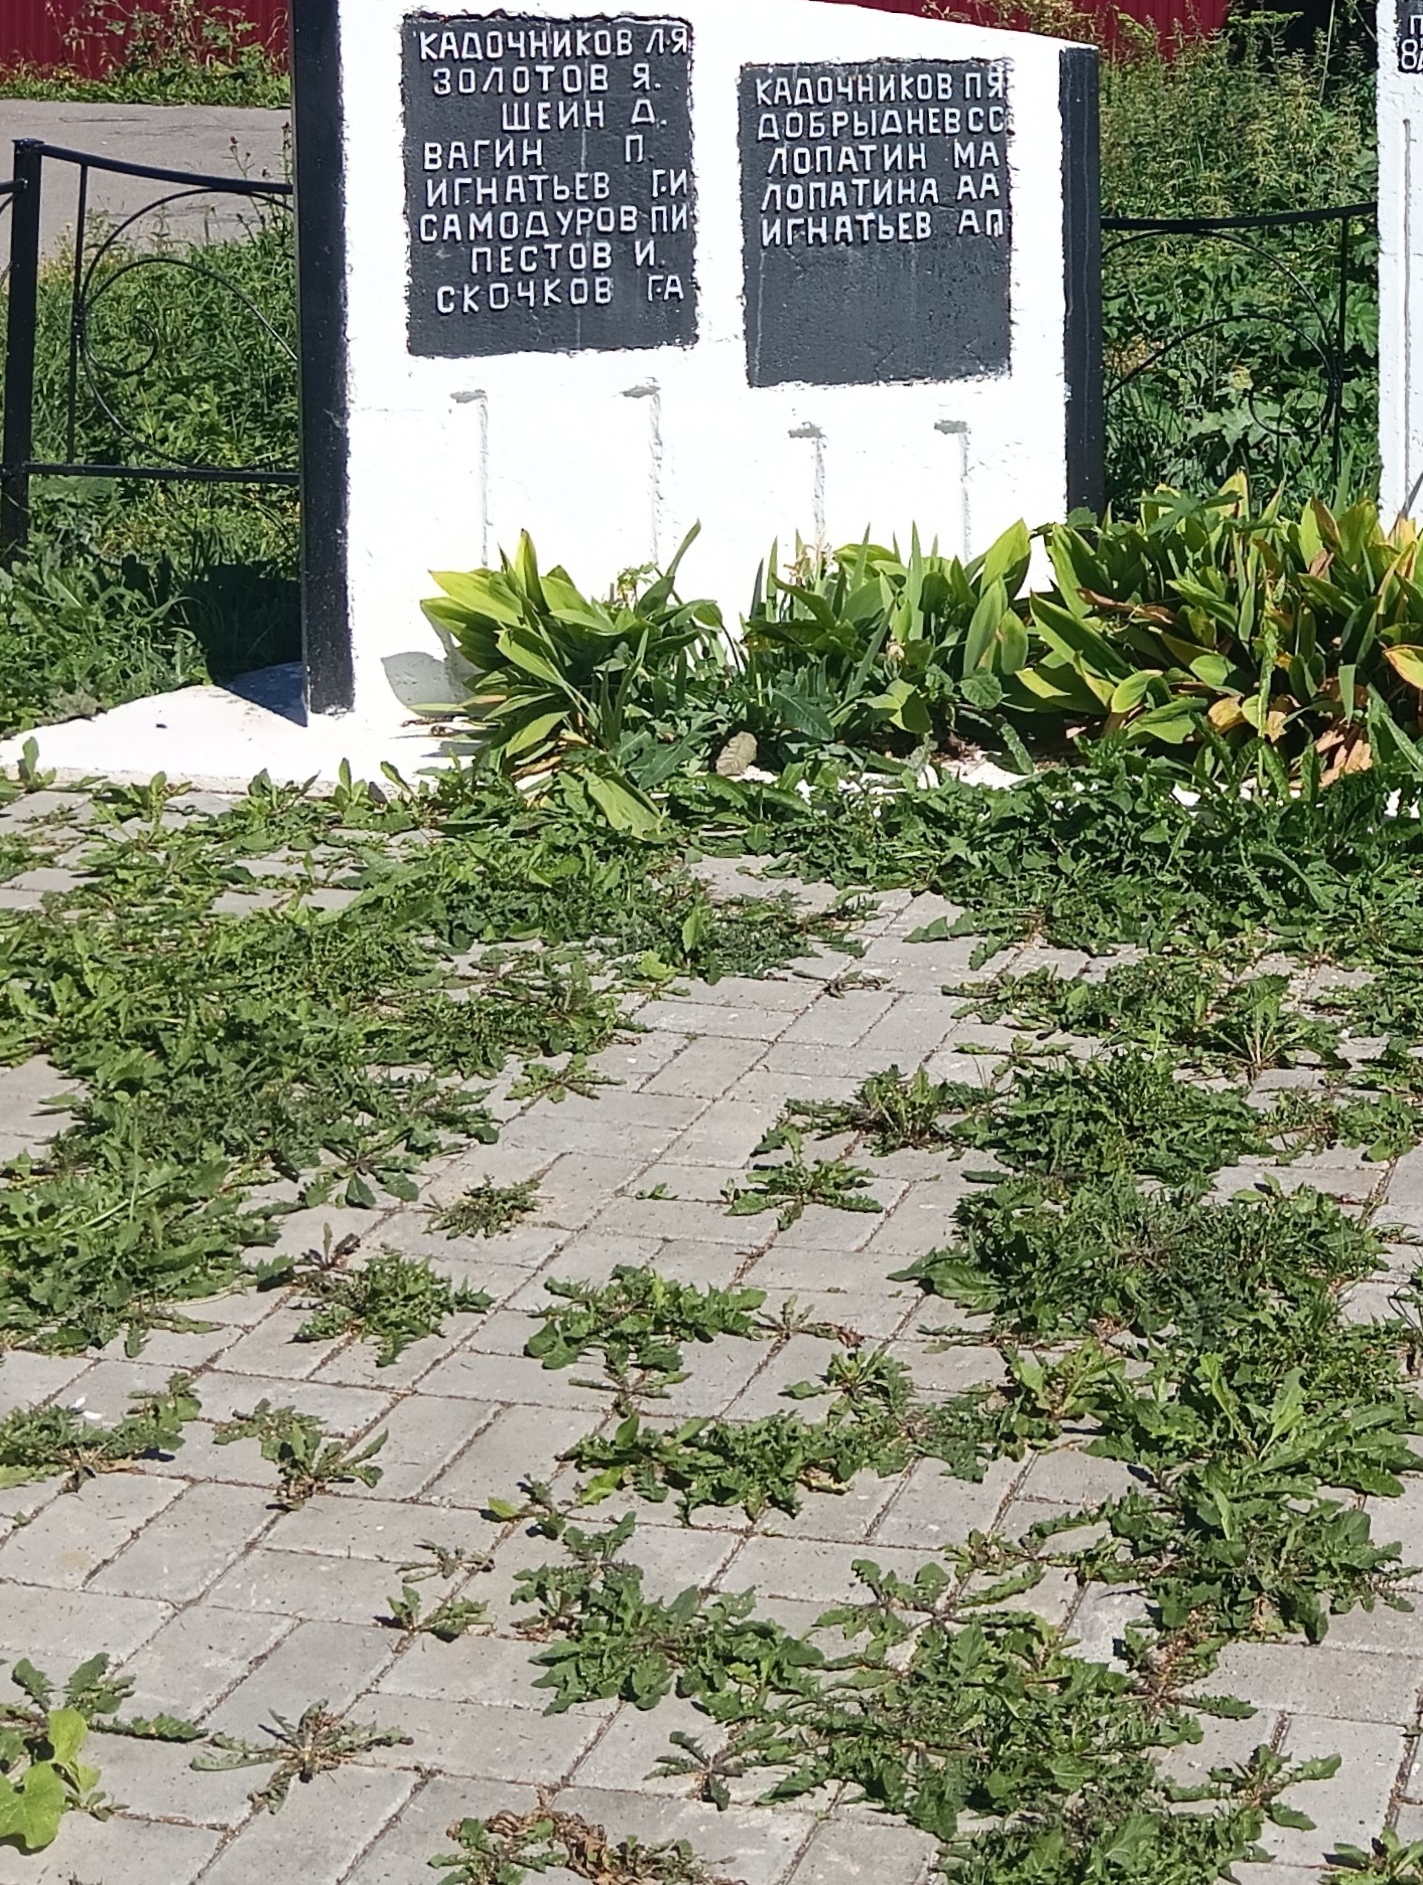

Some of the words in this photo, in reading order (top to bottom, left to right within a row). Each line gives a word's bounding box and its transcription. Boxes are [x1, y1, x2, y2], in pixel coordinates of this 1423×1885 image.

[418, 29, 633, 61] КАДОЧНИКОВ
[432, 64, 609, 96] ЗОЛОТОВ
[755, 73, 953, 106] КАДОЧНИКОВ
[964, 72, 1004, 100] ПЯ
[502, 99, 605, 131] ШЕИН
[756, 107, 961, 142] ДОБРЫДНЕВ
[967, 106, 1005, 133] СС
[423, 139, 543, 171] ВАГИН
[767, 143, 927, 176] ЛОПАТИН
[953, 140, 1000, 170] МА
[427, 171, 610, 208] ИГНАТЬЕВ
[760, 177, 939, 213] ЛОПАТИНА
[956, 172, 1000, 201] АА
[419, 205, 638, 243] САМОДУРОВ
[650, 204, 688, 234] ПИ
[761, 211, 932, 247] ИГНАТЬЕВ
[471, 242, 613, 275] ПЕСТОВ
[436, 276, 614, 314] СКОЧКОВ
